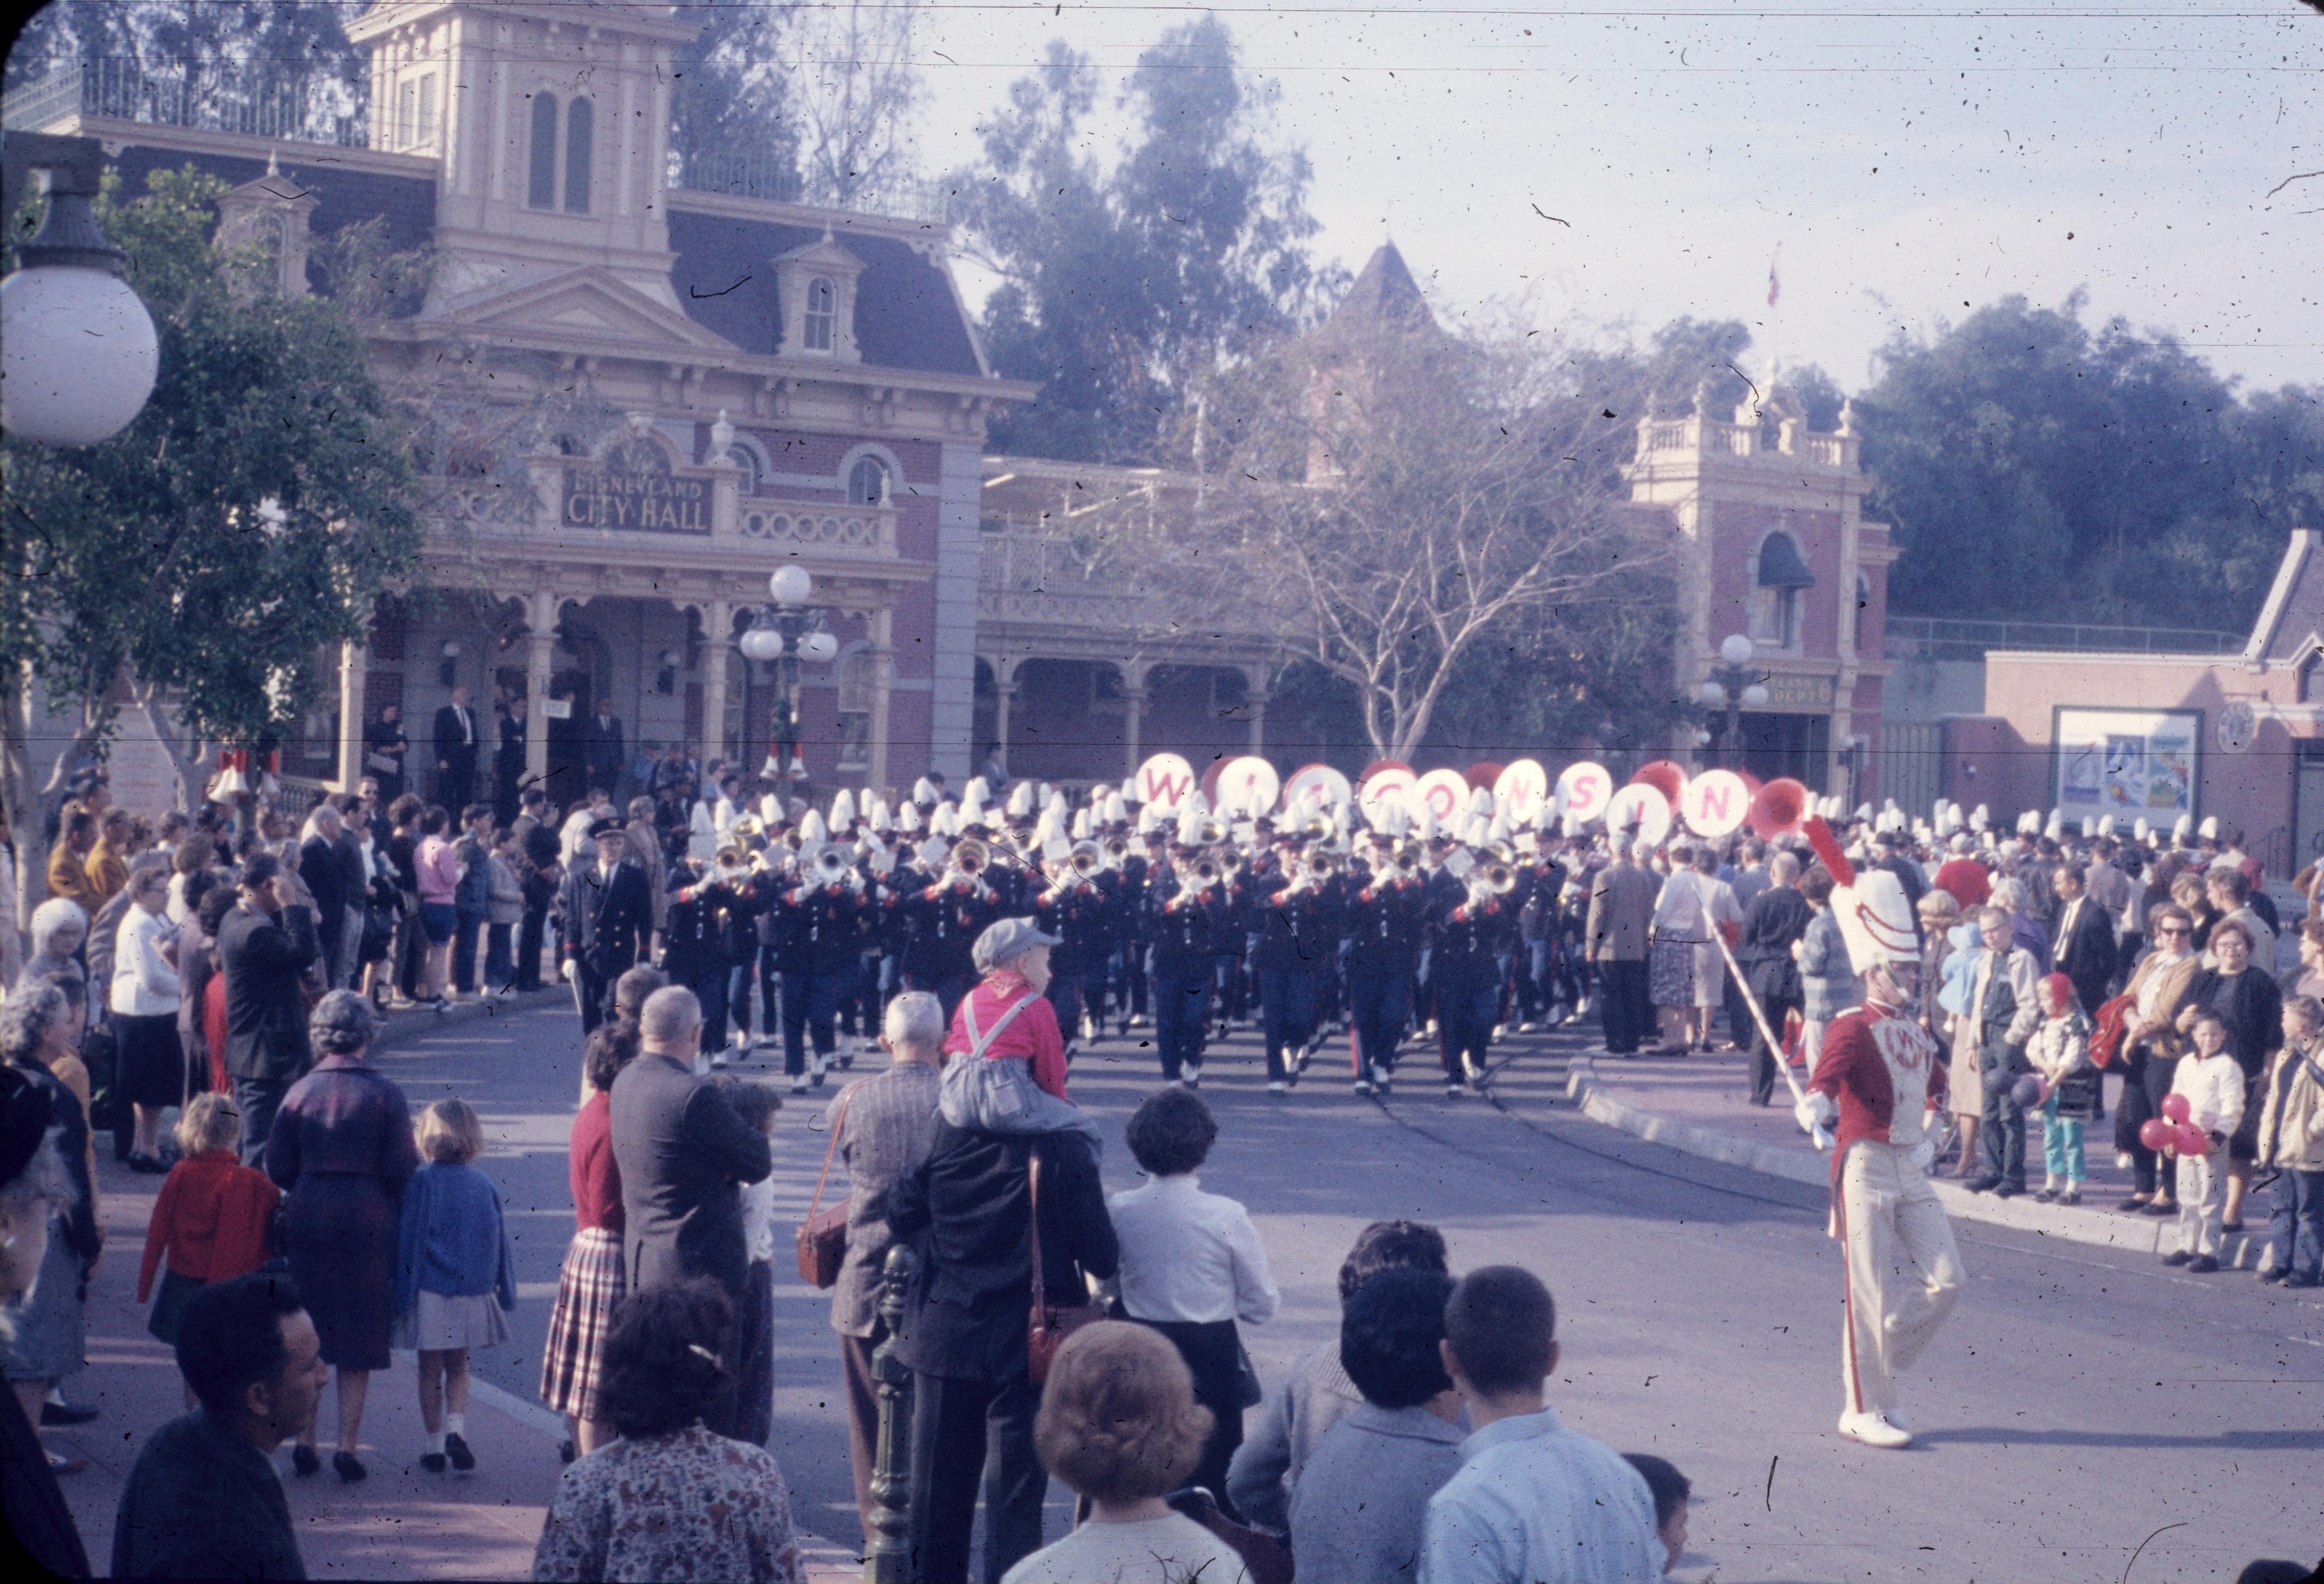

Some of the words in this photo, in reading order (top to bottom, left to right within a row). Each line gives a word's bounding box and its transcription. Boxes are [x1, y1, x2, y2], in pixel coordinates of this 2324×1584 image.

[575, 474, 702, 499] DISNEYLAND
[568, 493, 631, 525] CITY
[641, 499, 707, 529] HALL
